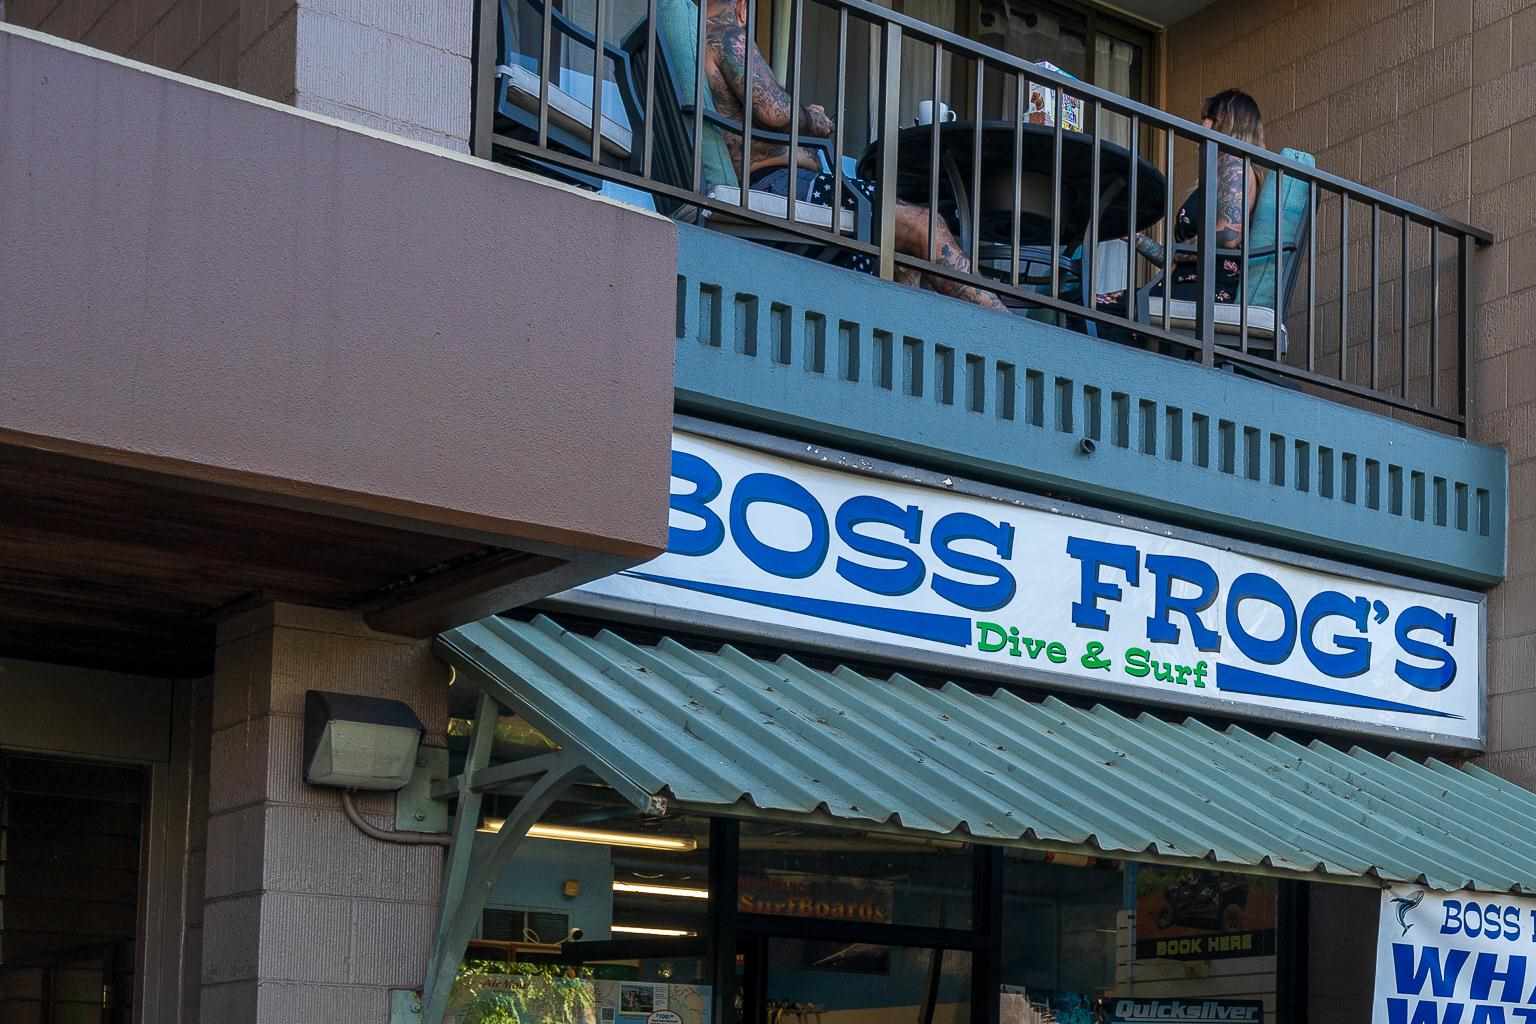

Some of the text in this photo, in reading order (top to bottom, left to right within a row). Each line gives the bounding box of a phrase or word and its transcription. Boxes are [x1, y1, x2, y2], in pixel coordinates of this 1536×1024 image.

[667, 450, 1457, 692] BOSS FROG'S
[976, 621, 1208, 688] Dive & Surf
[1440, 900, 1520, 941] BOSS
[1115, 1000, 1258, 1019] Quicksilver
